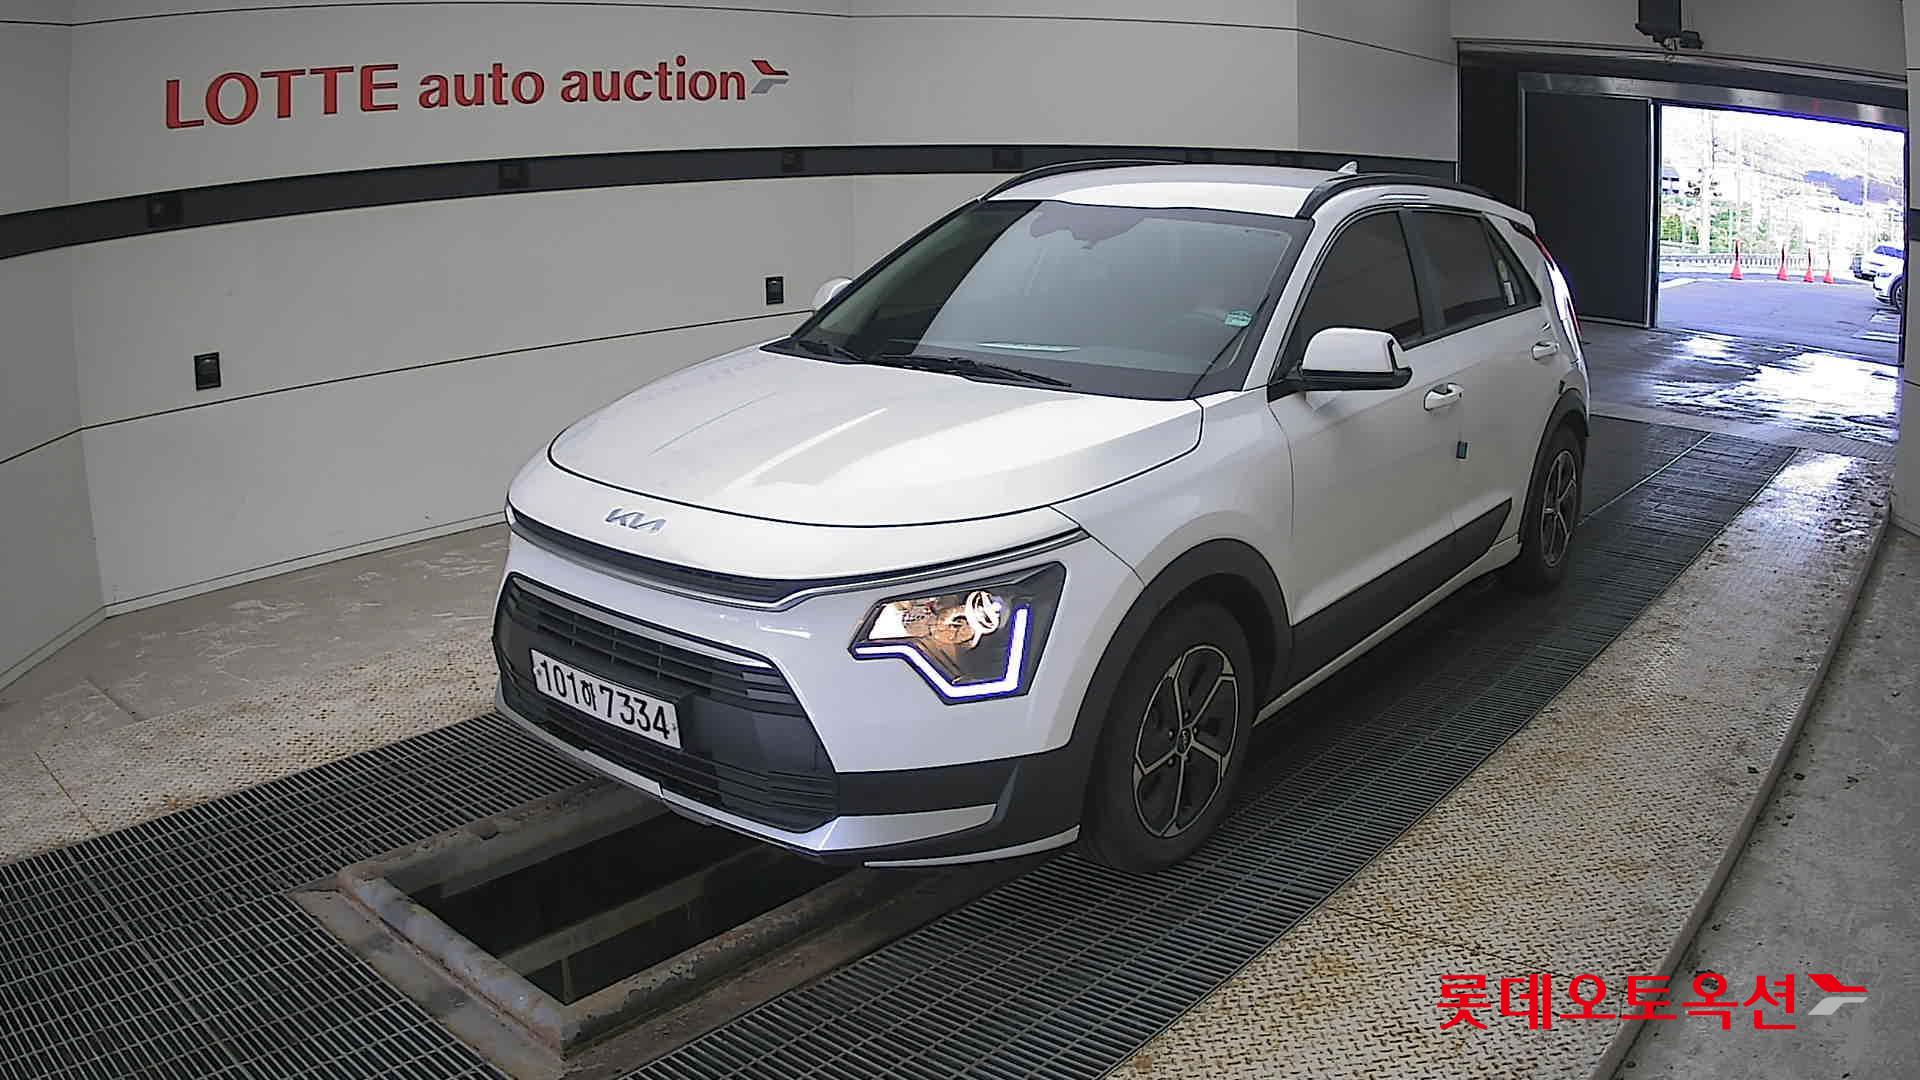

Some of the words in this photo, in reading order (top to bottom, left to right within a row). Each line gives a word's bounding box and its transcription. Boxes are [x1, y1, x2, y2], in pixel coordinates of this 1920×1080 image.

[165, 63, 399, 129] LOTTE
[418, 62, 545, 108] auto
[560, 55, 747, 103] auction
